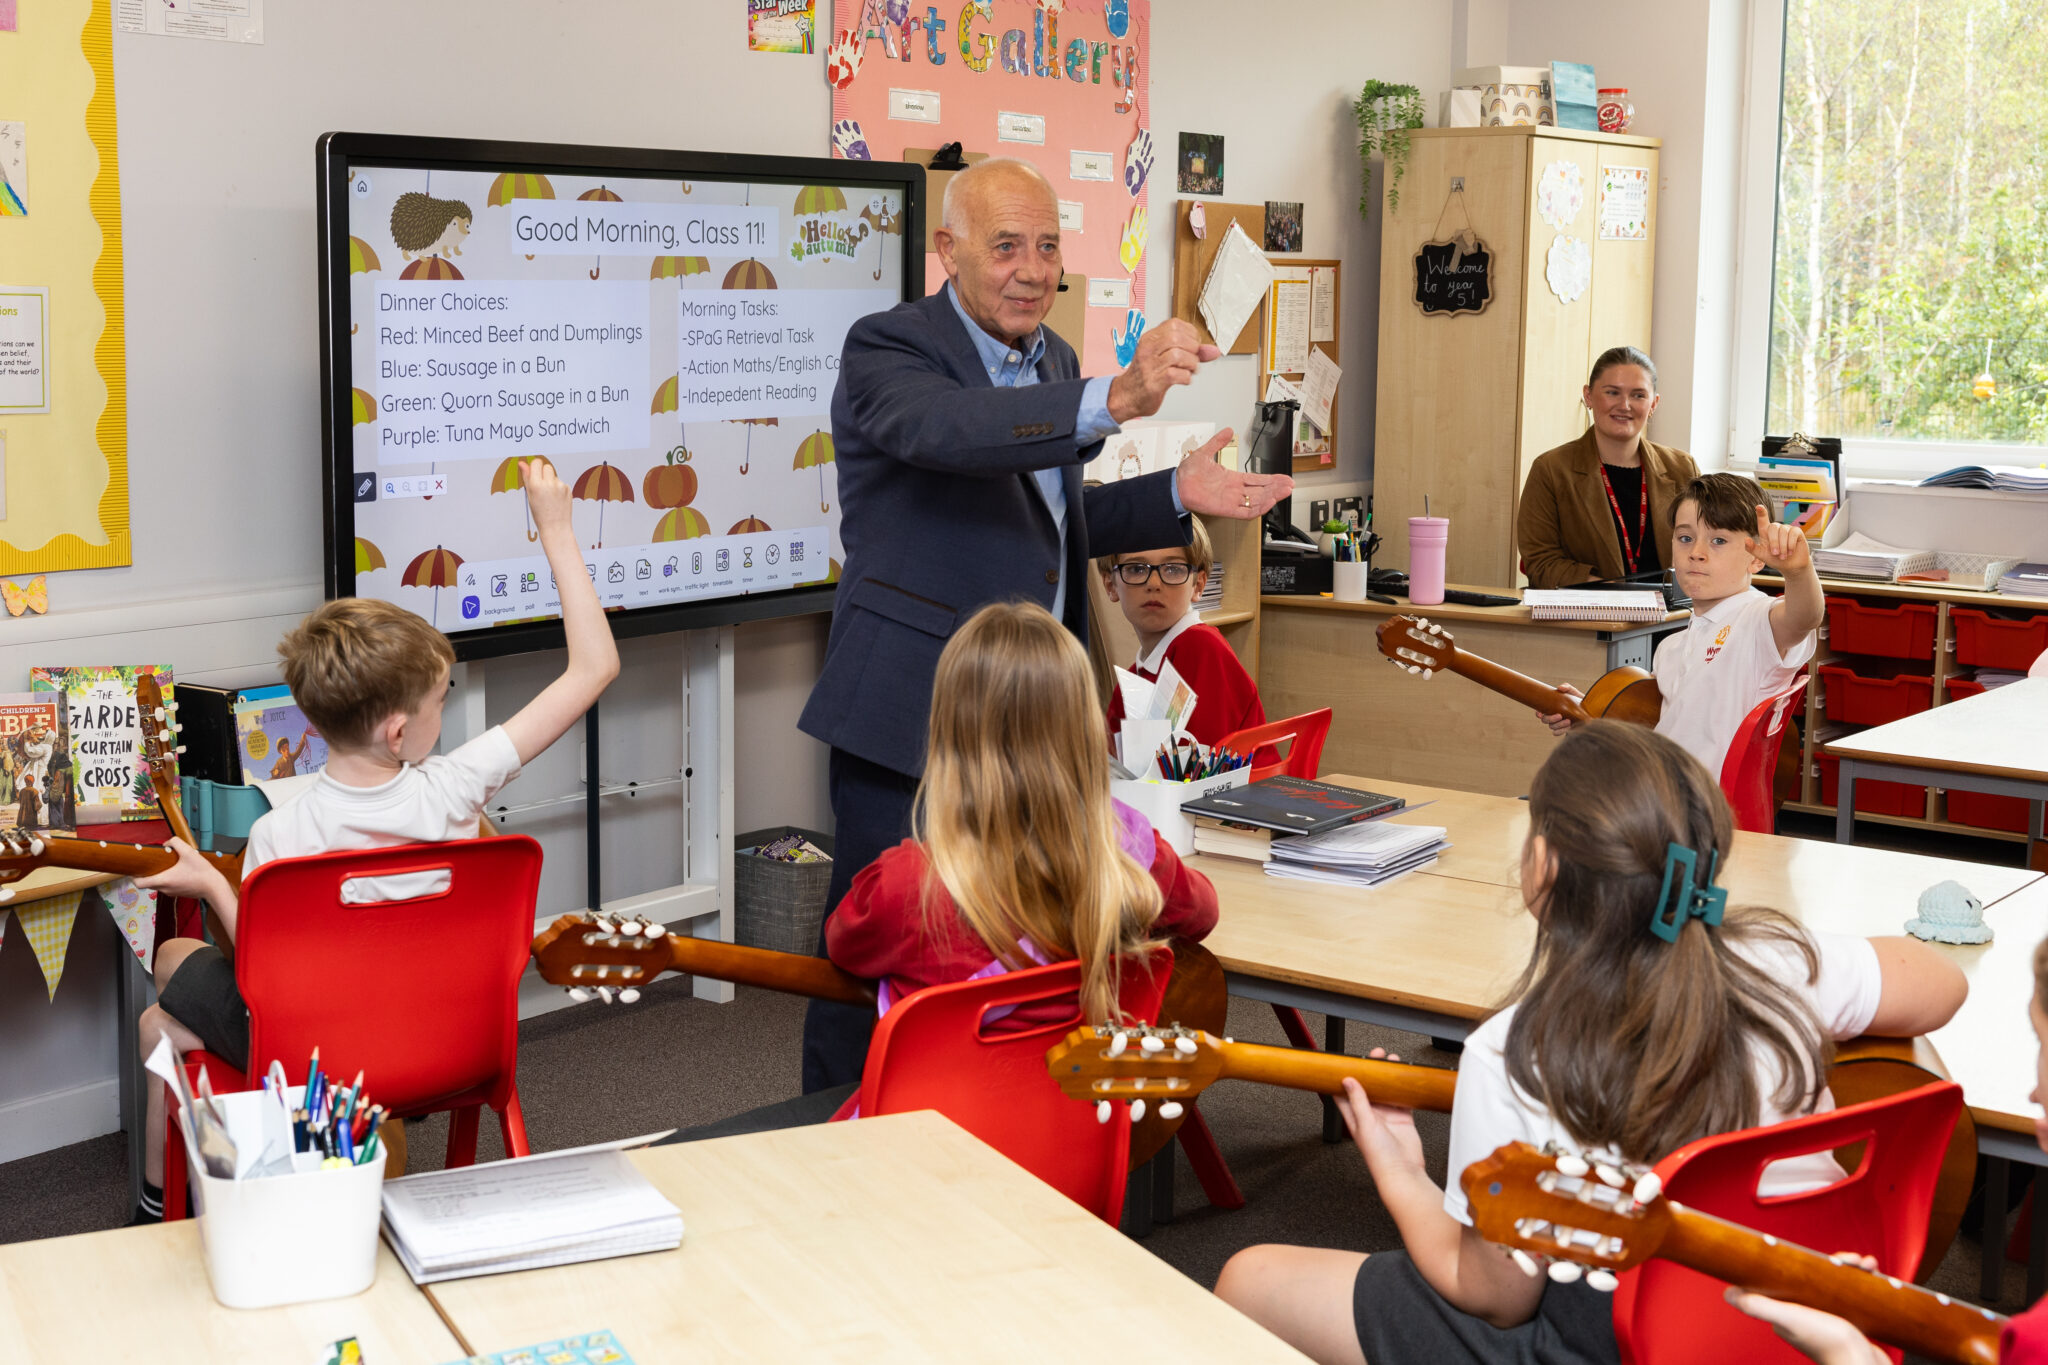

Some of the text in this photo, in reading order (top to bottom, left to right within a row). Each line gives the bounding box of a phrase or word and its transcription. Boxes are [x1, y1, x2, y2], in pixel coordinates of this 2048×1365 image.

[857, 0, 1135, 114] Art Gallery
[516, 216, 765, 249] Good Morning, Class 11!
[806, 220, 845, 243] Hello
[806, 239, 855, 258] autumn
[1427, 255, 1484, 275] Wecome
[1424, 273, 1474, 298] to year
[380, 293, 508, 311] Dinner Choices:
[682, 300, 778, 320] Morning Tasks:
[381, 323, 643, 345] Red: Minced Beef and Dumplings
[682, 328, 814, 346] -SPaG Retrieval Task
[381, 356, 566, 379] Blue: Sausage in a Bun
[682, 355, 840, 375] -Action Maths/English Co
[382, 386, 629, 413] Green: Quorn Sausage in a Bun
[766, 384, 817, 401] Reading
[383, 417, 610, 448] Purple: Tuna Mayo Sandwich
[484, 606, 515, 615] background
[96, 690, 113, 700] THE
[81, 740, 132, 755] CURTAIN
[84, 766, 130, 787] CROSS
